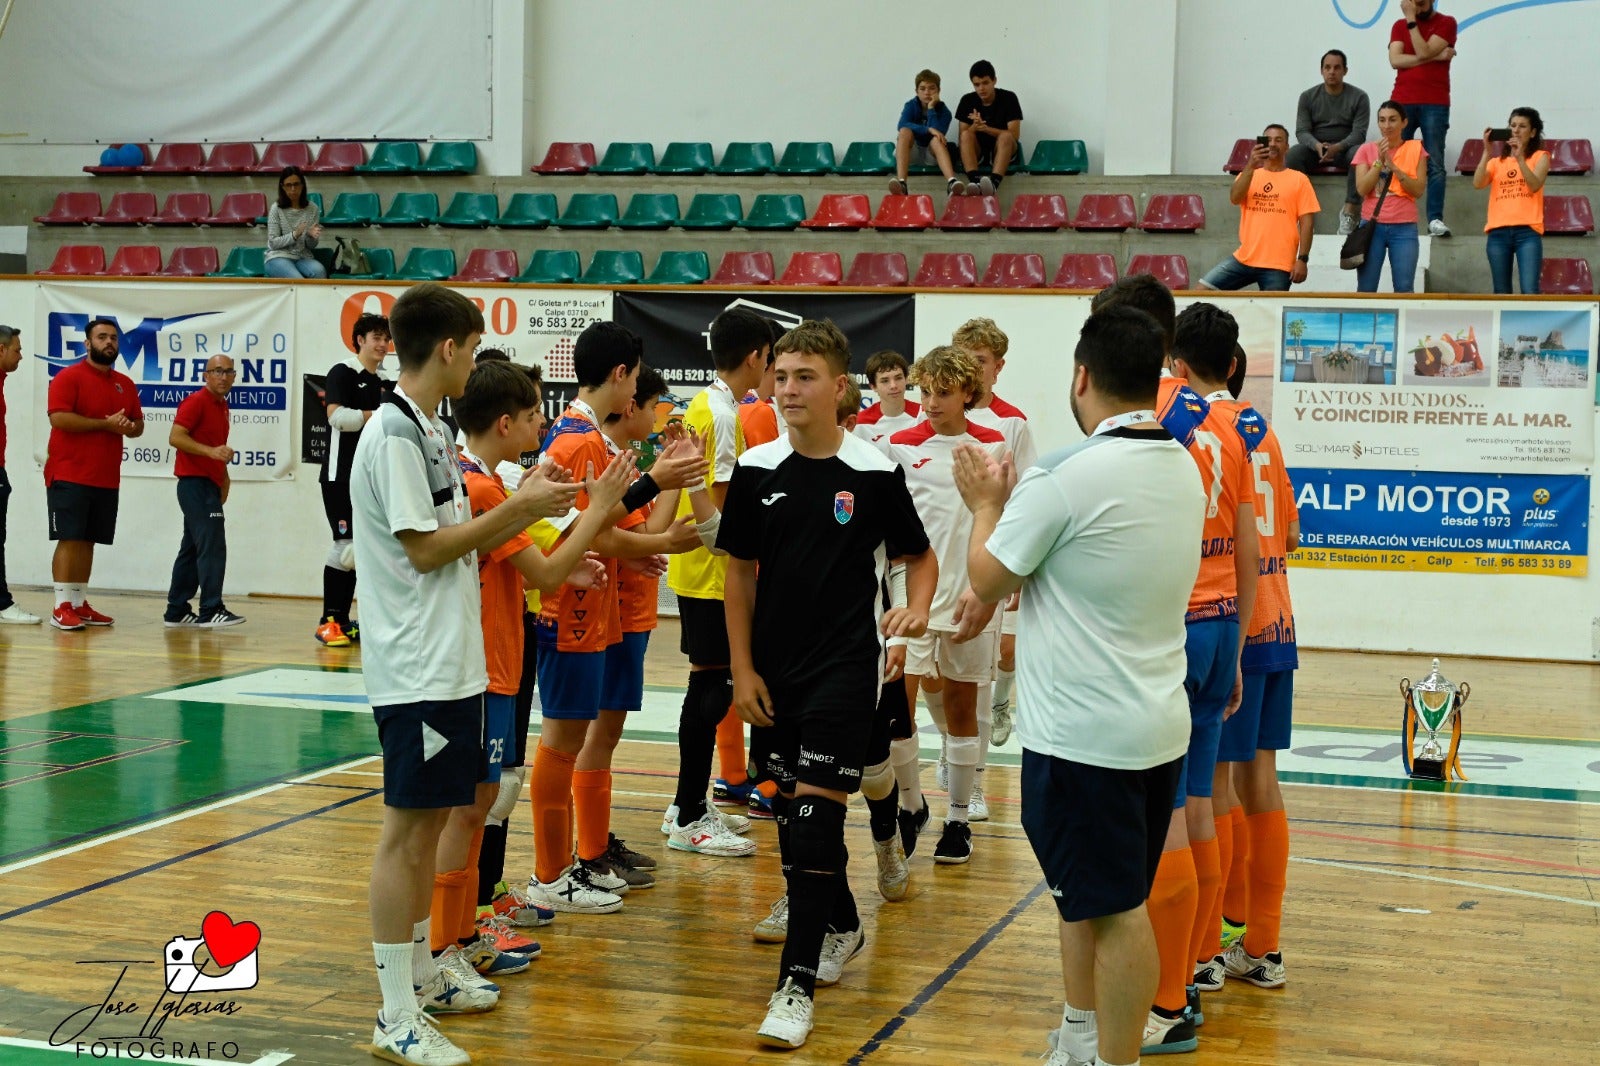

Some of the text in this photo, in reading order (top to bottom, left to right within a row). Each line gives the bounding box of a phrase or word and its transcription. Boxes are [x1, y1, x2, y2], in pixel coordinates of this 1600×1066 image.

[528, 299, 537, 307] C/
[538, 299, 562, 307] Goleta
[579, 300, 599, 308] Local
[544, 309, 589, 317] Calpe 03710
[529, 317, 544, 328] 96
[546, 317, 567, 328] 583
[571, 317, 585, 328] 22
[168, 332, 287, 354] GRUPO
[168, 358, 287, 384] ORNO
[663, 369, 683, 382] 646
[684, 369, 705, 382] 520
[1294, 389, 1485, 408] TANTOS MUNDOS...
[1294, 407, 1572, 428] Y COINCIDIR FRENTE AL MAR.
[134, 448, 161, 463] 669
[1294, 443, 1420, 457] SOLYMAR HOTELES
[1480, 454, 1571, 463] www.solymarhoteles.com
[244, 451, 277, 467] 356
[1193, 429, 1223, 518] 7
[1251, 451, 1275, 537] 5
[1296, 482, 1511, 515] ALP MOTOR
[1441, 515, 1479, 527] desde
[1482, 516, 1511, 527] 1973
[1523, 507, 1557, 522] plus
[1307, 533, 1324, 544] DE
[1327, 534, 1408, 547] REPARACIÓN
[1411, 535, 1483, 549] VEHÍCULOS
[1486, 538, 1572, 551] MULTIMARCA
[1307, 551, 1326, 561] 332
[1329, 552, 1377, 563] Estación
[1391, 554, 1406, 564] 2C
[1427, 555, 1453, 567] Calp
[1474, 556, 1498, 568] Telf.
[1501, 557, 1515, 567] 96
[1518, 557, 1538, 568] 583
[1541, 558, 1555, 568] 33
[1558, 559, 1572, 569] 89
[489, 738, 504, 763] 25
